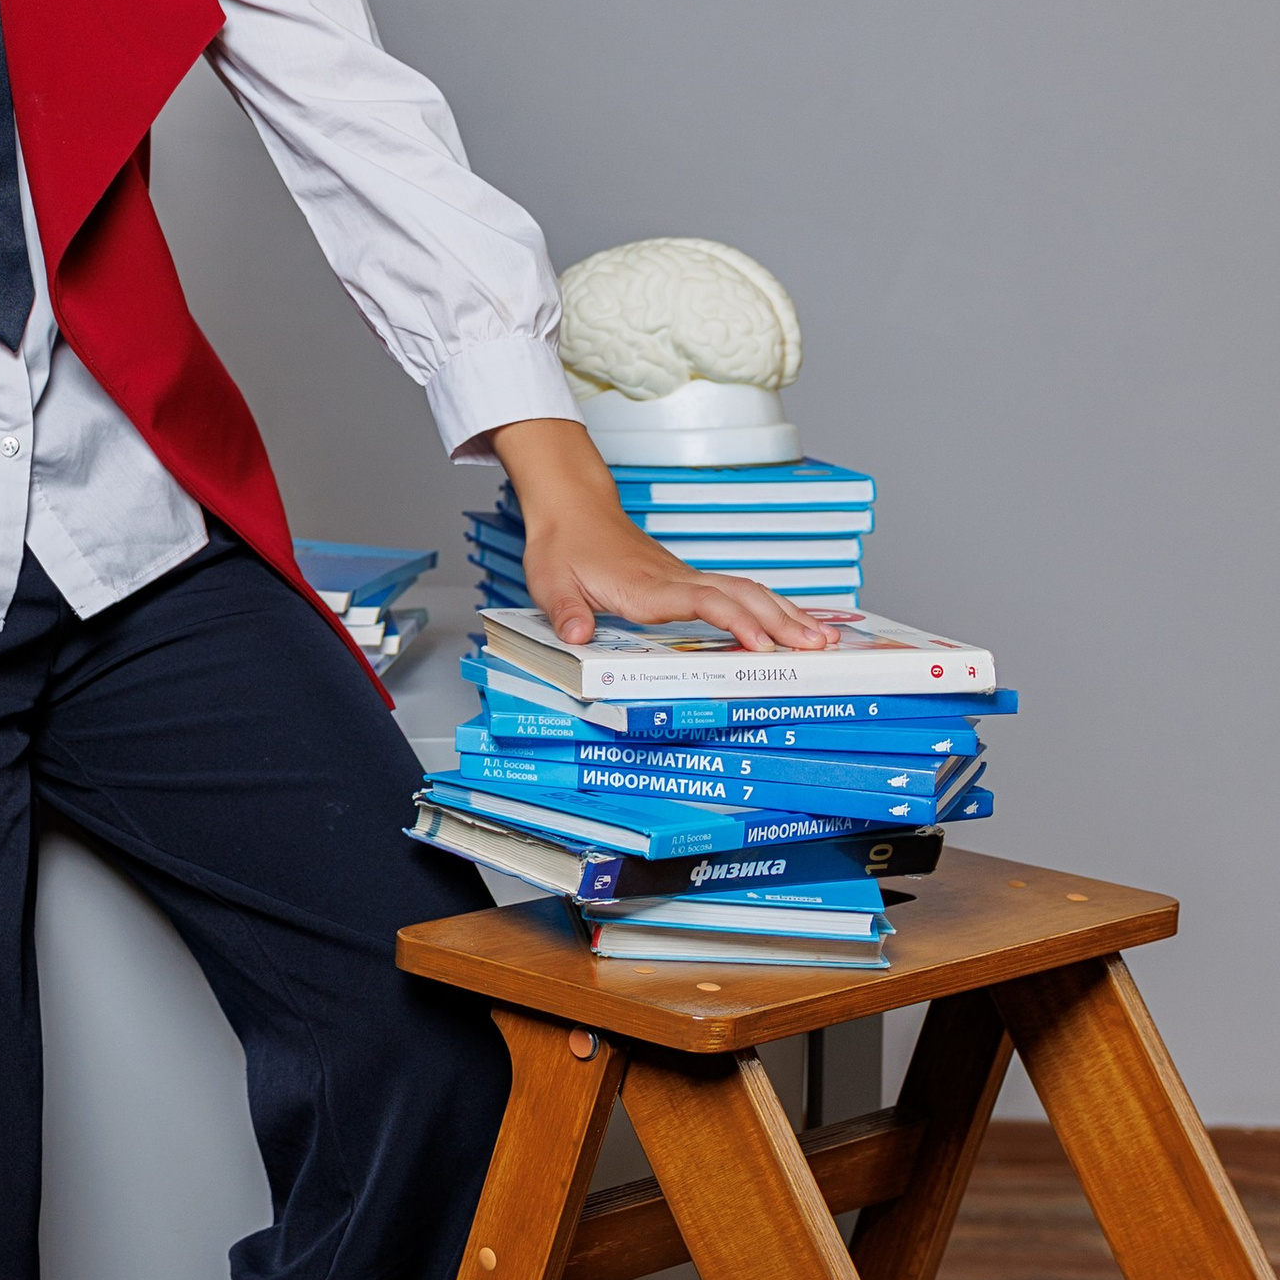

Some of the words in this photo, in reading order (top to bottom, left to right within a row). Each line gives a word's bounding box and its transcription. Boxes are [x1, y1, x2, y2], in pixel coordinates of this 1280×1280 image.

[639, 673, 680, 683] Перышкин,
[735, 668, 798, 682] ФИЗИКА
[732, 703, 856, 722] ИНФОРМАТИКА
[868, 702, 878, 716] 6
[538, 716, 572, 726] Босова
[541, 727, 574, 737] Босова
[785, 730, 796, 745] 5
[503, 760, 536, 771] Босова
[579, 745, 724, 773] ИНФОРМАТИКА
[740, 760, 752, 775] 5
[506, 770, 538, 781] Босова
[582, 770, 727, 798] ИНФОРМАТИКА
[742, 785, 754, 801] 7
[747, 817, 853, 843] ИНФОРМАТИКА
[687, 833, 712, 843] Босова
[687, 843, 713, 853] Босова
[865, 842, 894, 875] 10
[690, 858, 787, 887] физика
